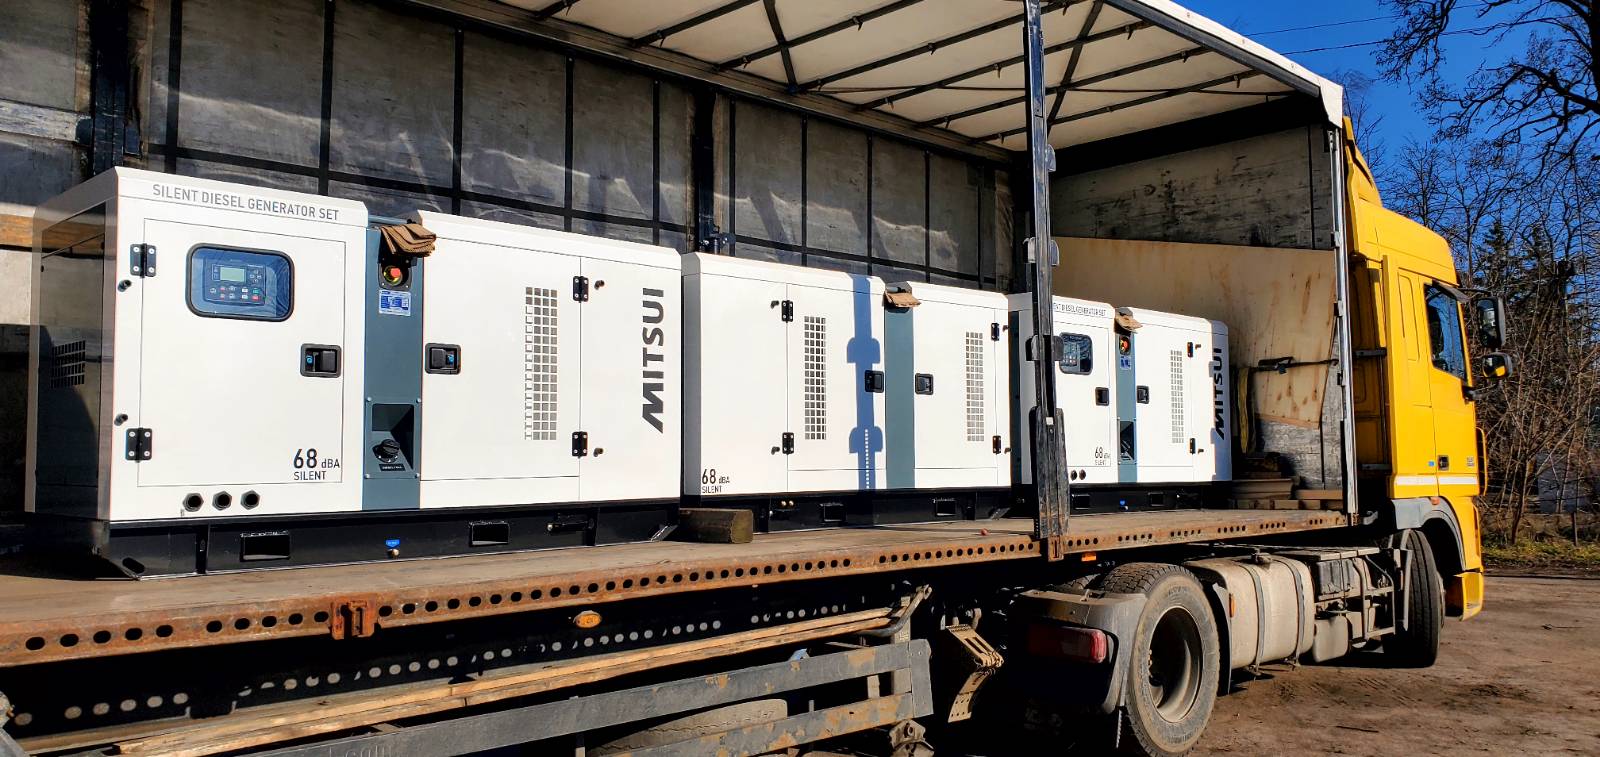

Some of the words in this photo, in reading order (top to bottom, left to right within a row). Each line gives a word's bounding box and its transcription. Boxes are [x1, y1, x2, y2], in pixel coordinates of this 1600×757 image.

[153, 184, 198, 202] SILENT
[201, 191, 245, 209] DIESEL
[248, 199, 315, 218] GENERATOR
[318, 209, 339, 221] SET
[642, 287, 664, 434] MITSUI
[1213, 347, 1225, 441] MITSUI
[293, 448, 318, 469] 68
[321, 458, 340, 469] dBA
[1094, 446, 1103, 459] 68
[293, 470, 327, 481] SILENT
[702, 468, 717, 485] 68
[702, 485, 722, 494] SILENT
